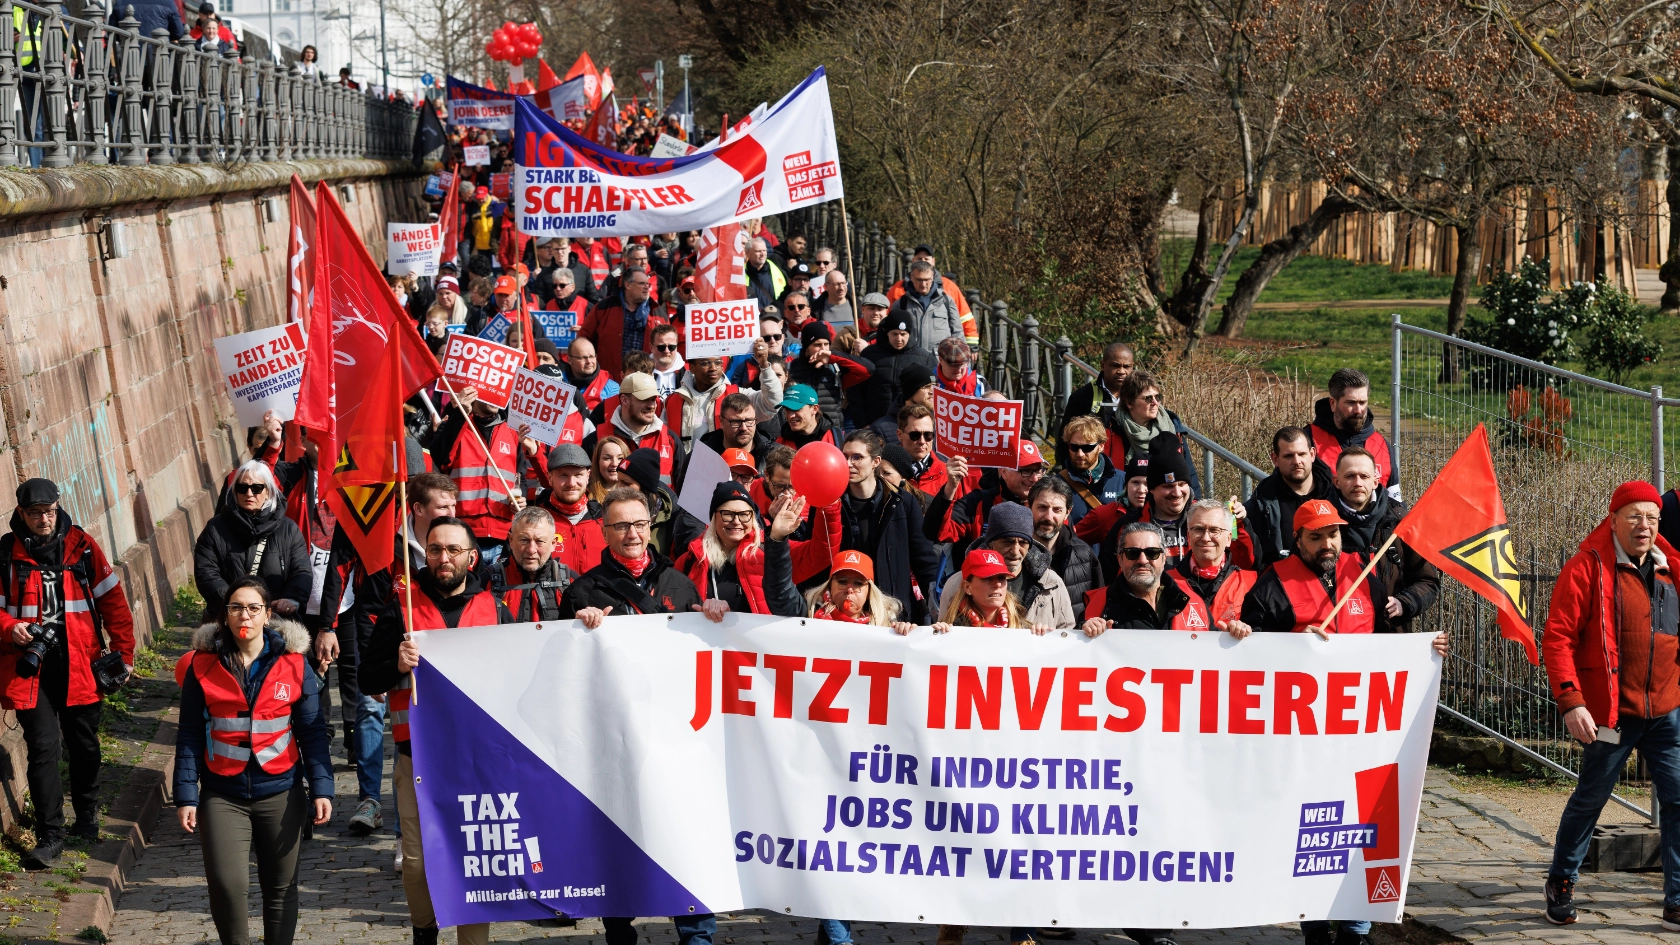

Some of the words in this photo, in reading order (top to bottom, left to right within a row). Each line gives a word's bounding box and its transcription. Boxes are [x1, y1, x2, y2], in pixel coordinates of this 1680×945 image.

[454, 106, 479, 120] JOHN
[481, 105, 514, 117] DEERE
[524, 132, 565, 168] IG
[784, 154, 809, 170] WEIL
[525, 169, 575, 184] STARK
[787, 173, 807, 186] DAS
[808, 164, 836, 182] JETZT
[523, 184, 695, 214] SCHAEFFLER
[790, 185, 822, 201] ZÄHLT.
[393, 229, 431, 243] HÄNDE
[523, 216, 539, 231] IN
[542, 214, 617, 231] HOMBURG
[691, 304, 755, 325] BOSCH
[691, 323, 755, 342] BLEIBT
[233, 344, 266, 369] ZEIT
[268, 335, 291, 355] ZU
[448, 338, 521, 374] BOSCH
[234, 376, 279, 399] INVESTIEREN
[277, 367, 301, 382] STATT
[443, 357, 514, 390] BLEIBT
[514, 373, 570, 409] BOSCH
[511, 392, 563, 426] BLEIBT
[936, 394, 1017, 428] BOSCH
[936, 416, 1015, 449] BLEIBT
[961, 446, 972, 455] Für
[689, 650, 904, 732] JETZT
[926, 665, 1409, 735] INVESTIEREN
[848, 743, 918, 786] FÜR
[930, 756, 1134, 796] INDUSTRIE,
[457, 792, 521, 822] TAX
[822, 794, 913, 834] JOBS
[924, 800, 1000, 835] UND
[1011, 804, 1139, 837] KLIMA!
[1304, 806, 1339, 824] WEIL
[460, 822, 522, 852] THE
[1300, 831, 1330, 849] DAS
[1331, 829, 1374, 849] JETZT
[735, 830, 973, 878] SOZIALSTAAT
[984, 848, 1235, 883] VERTEIDIGEN!
[1296, 854, 1344, 873] ZÄHLT.
[465, 888, 537, 904] Milliardäre
[539, 888, 561, 900] zur
[563, 884, 606, 899] Kasse!
